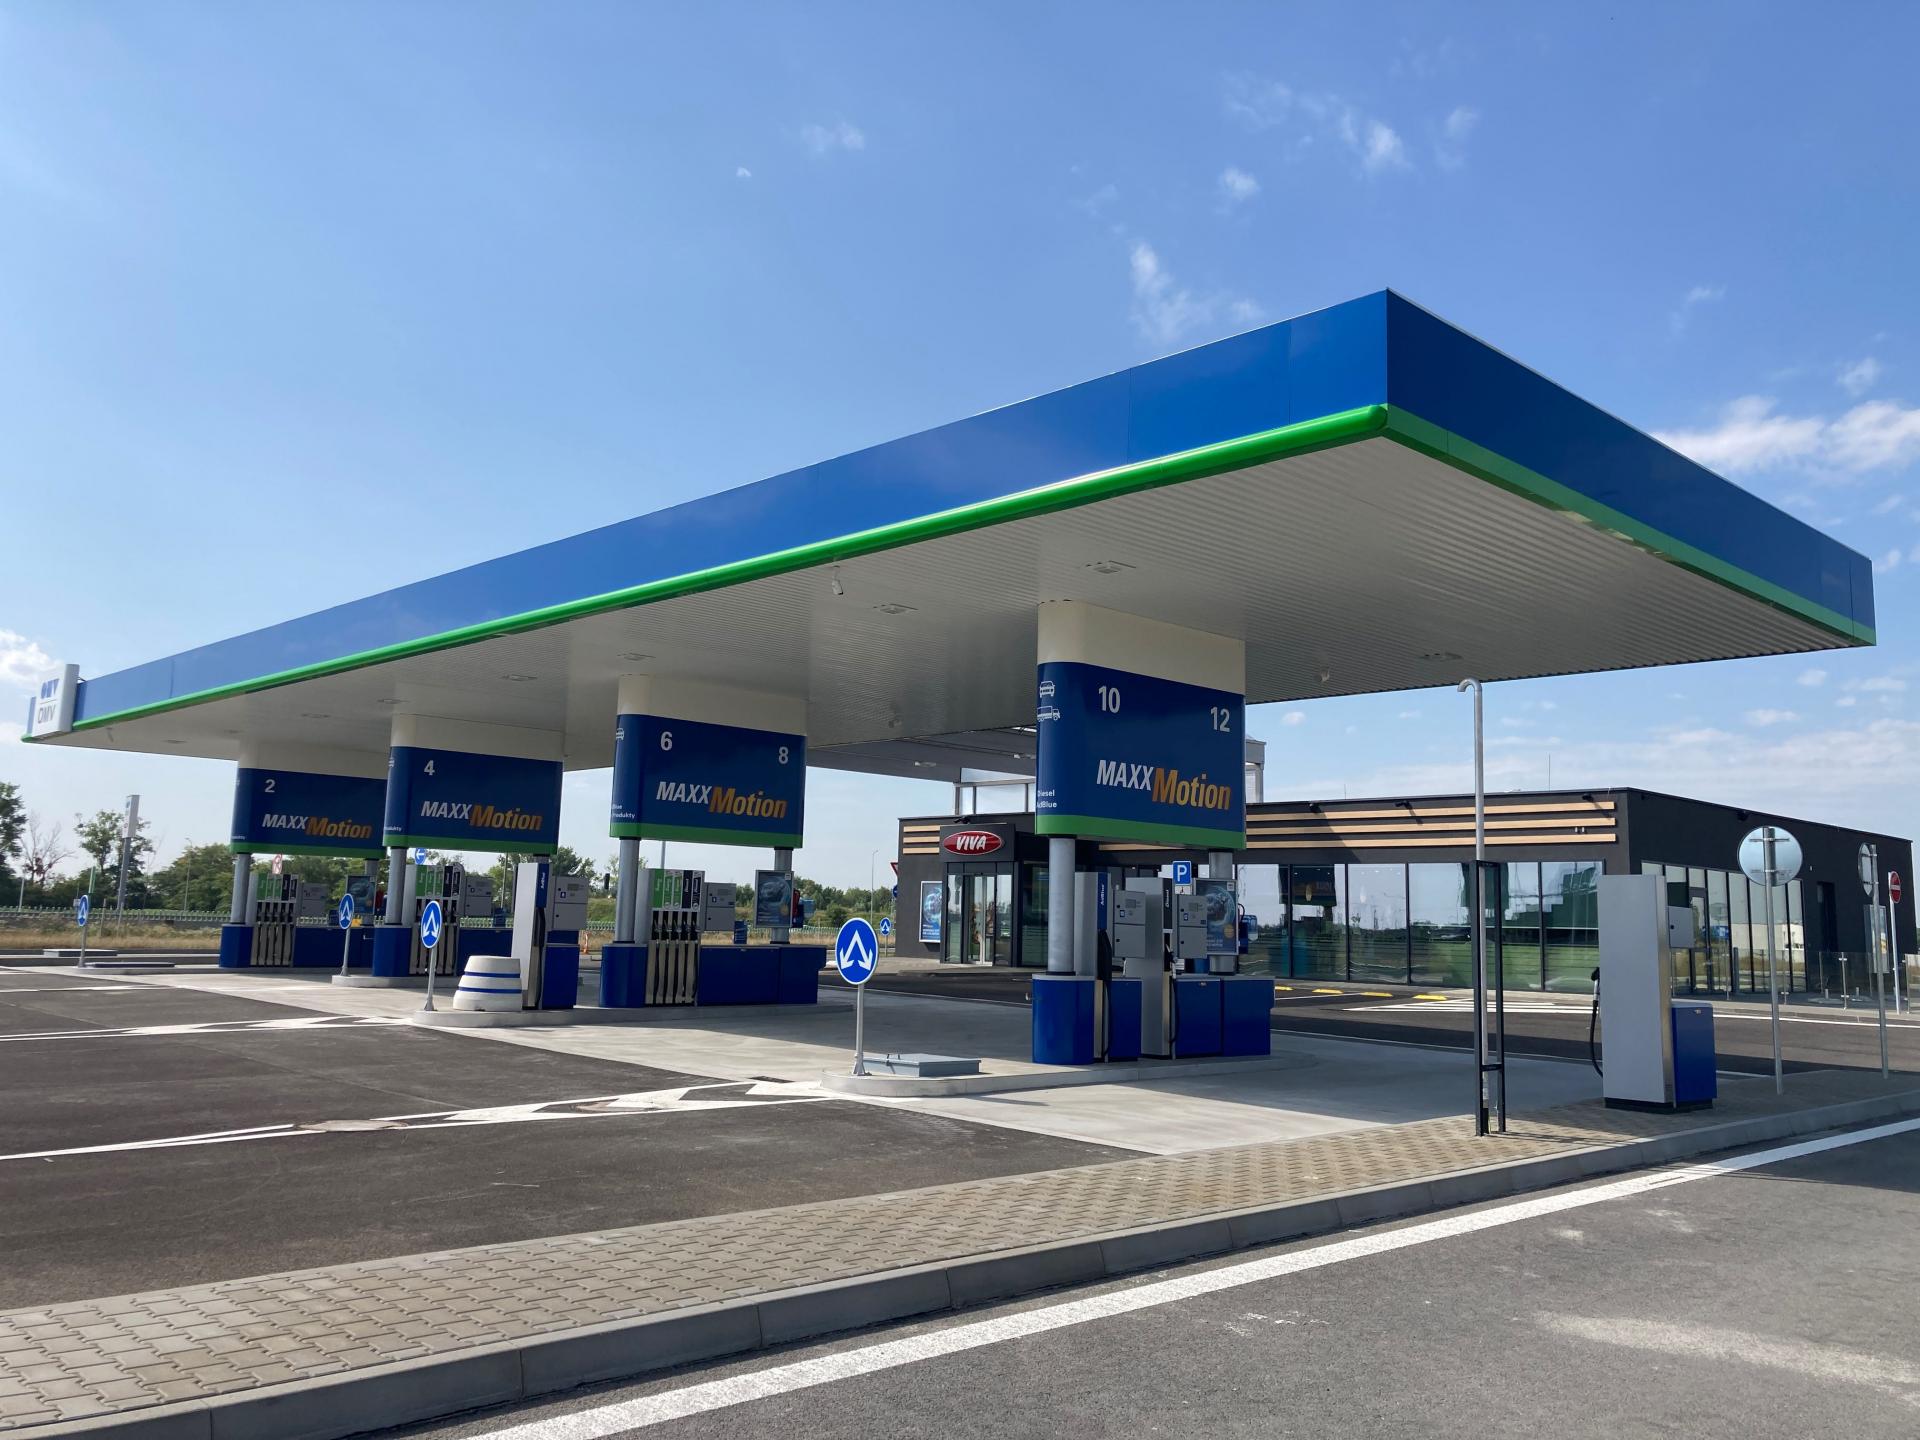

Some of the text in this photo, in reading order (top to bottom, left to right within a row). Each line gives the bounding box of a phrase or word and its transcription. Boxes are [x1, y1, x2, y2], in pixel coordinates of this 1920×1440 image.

[1098, 685, 1121, 714] 10
[1210, 706, 1231, 733] 12
[660, 731, 673, 751] 6
[778, 746, 789, 765] 8
[424, 760, 435, 776] 4
[264, 779, 276, 793] 2
[956, 835, 987, 851] VIVA
[1177, 864, 1188, 882] P
